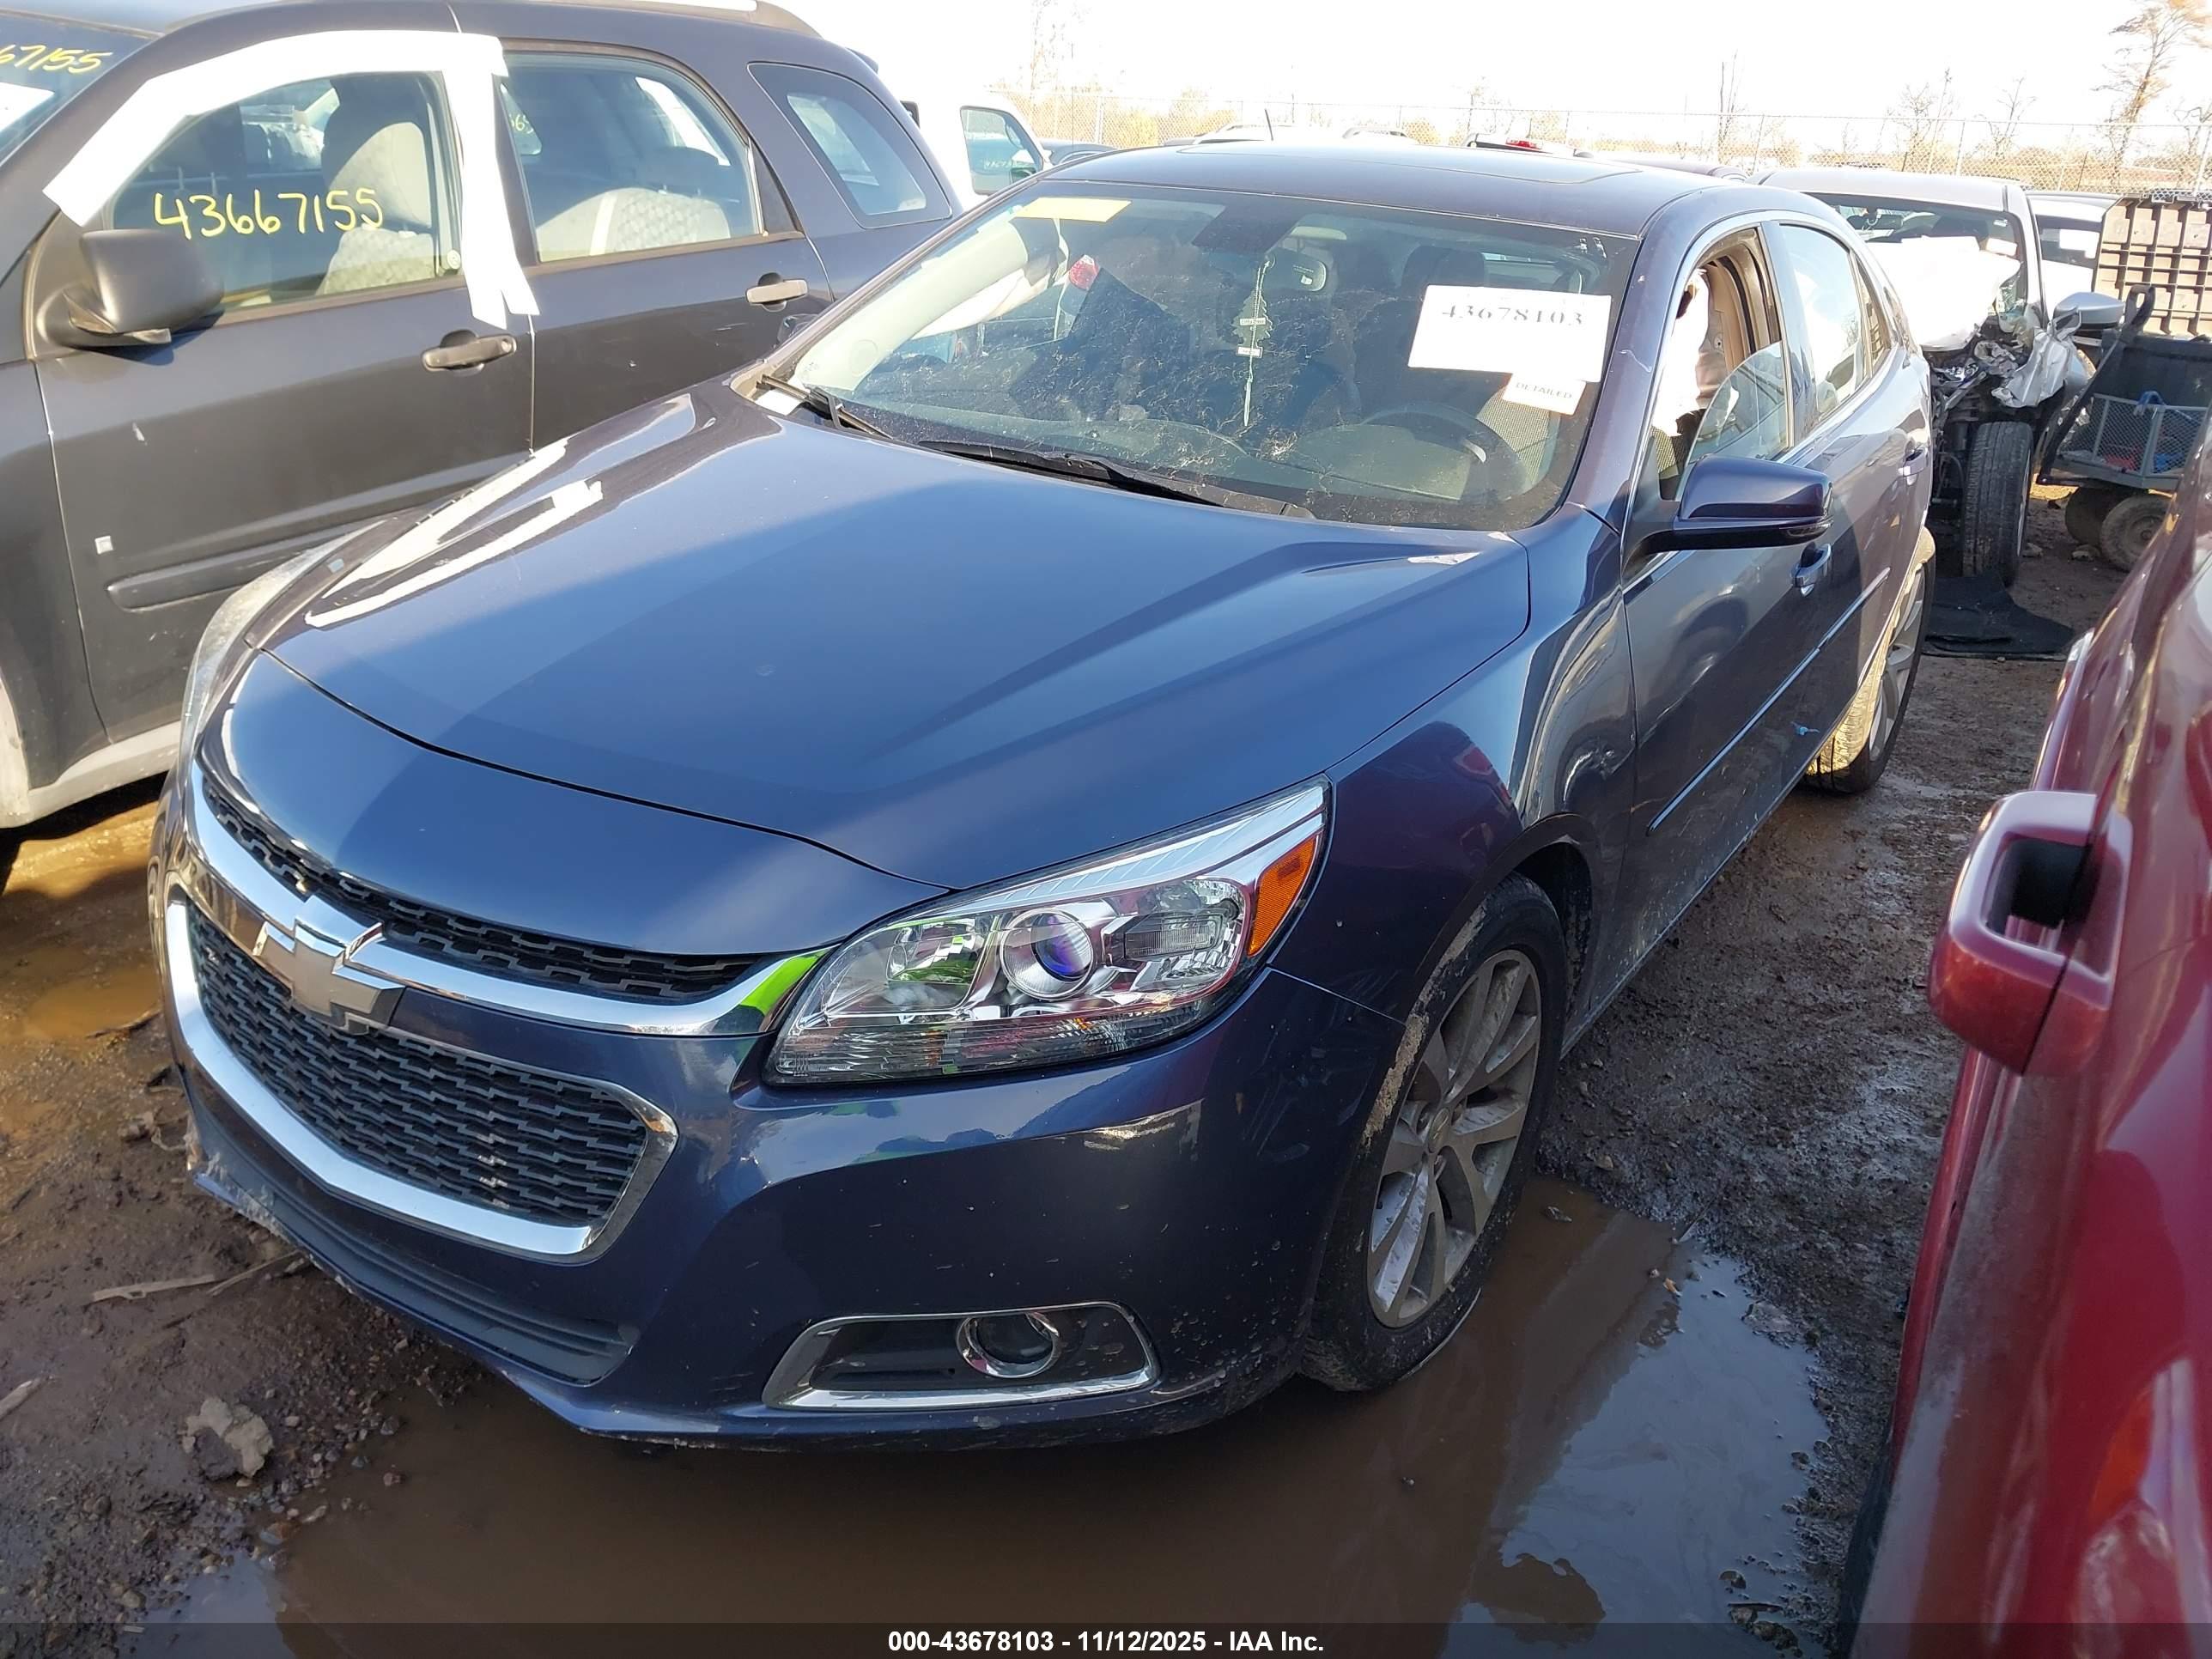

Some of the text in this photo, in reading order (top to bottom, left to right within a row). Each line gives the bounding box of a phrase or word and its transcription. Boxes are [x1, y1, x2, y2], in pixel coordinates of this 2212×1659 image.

[154, 188, 383, 240] 43667155
[1442, 304, 1583, 325] 43678103
[1515, 381, 1572, 399] DETAILED
